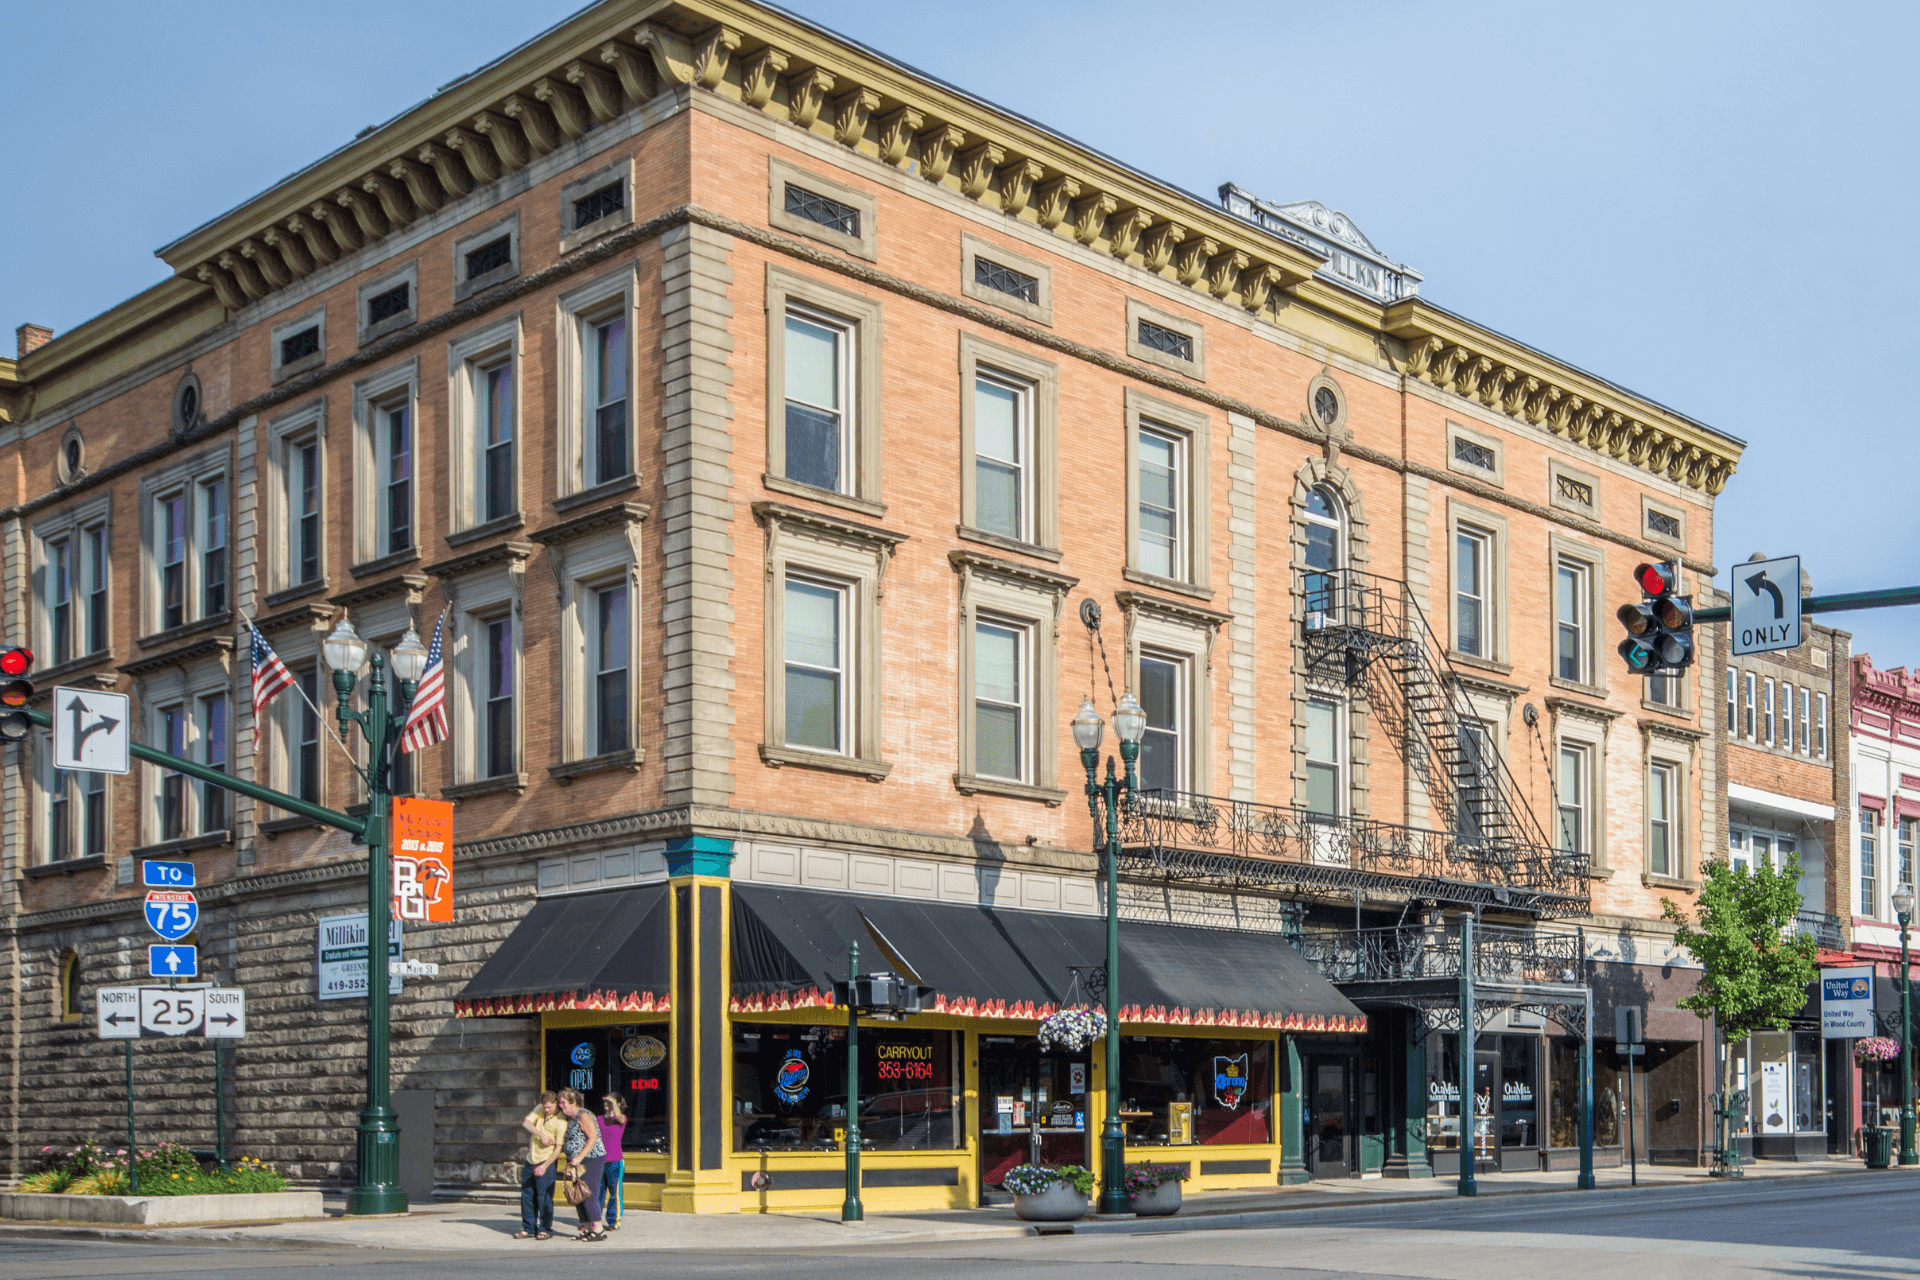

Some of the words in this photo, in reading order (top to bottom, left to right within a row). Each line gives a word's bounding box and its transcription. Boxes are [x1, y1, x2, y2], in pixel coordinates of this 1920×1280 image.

[1742, 623, 1791, 647] ONLY
[157, 866, 182, 881] TO
[152, 894, 190, 902] INTERSTATE
[150, 903, 192, 931] 75
[326, 924, 365, 946] Millikin
[406, 963, 423, 974] Main
[426, 964, 433, 974] St
[1826, 981, 1848, 990] United
[102, 992, 136, 1003] NORTH
[209, 993, 239, 1004] SOUTH
[1833, 989, 1849, 998] Way
[153, 1000, 194, 1025] 25
[1823, 1010, 1841, 1018] United
[1842, 1010, 1854, 1018] Way
[1830, 1020, 1845, 1028] Wood
[1846, 1020, 1866, 1028] County
[878, 1045, 933, 1060] CARRYOUT
[878, 1061, 933, 1079] 353-6164
[570, 1069, 593, 1090] OPEN
[631, 1078, 658, 1090] KENO
[1215, 1073, 1246, 1090] Corona
